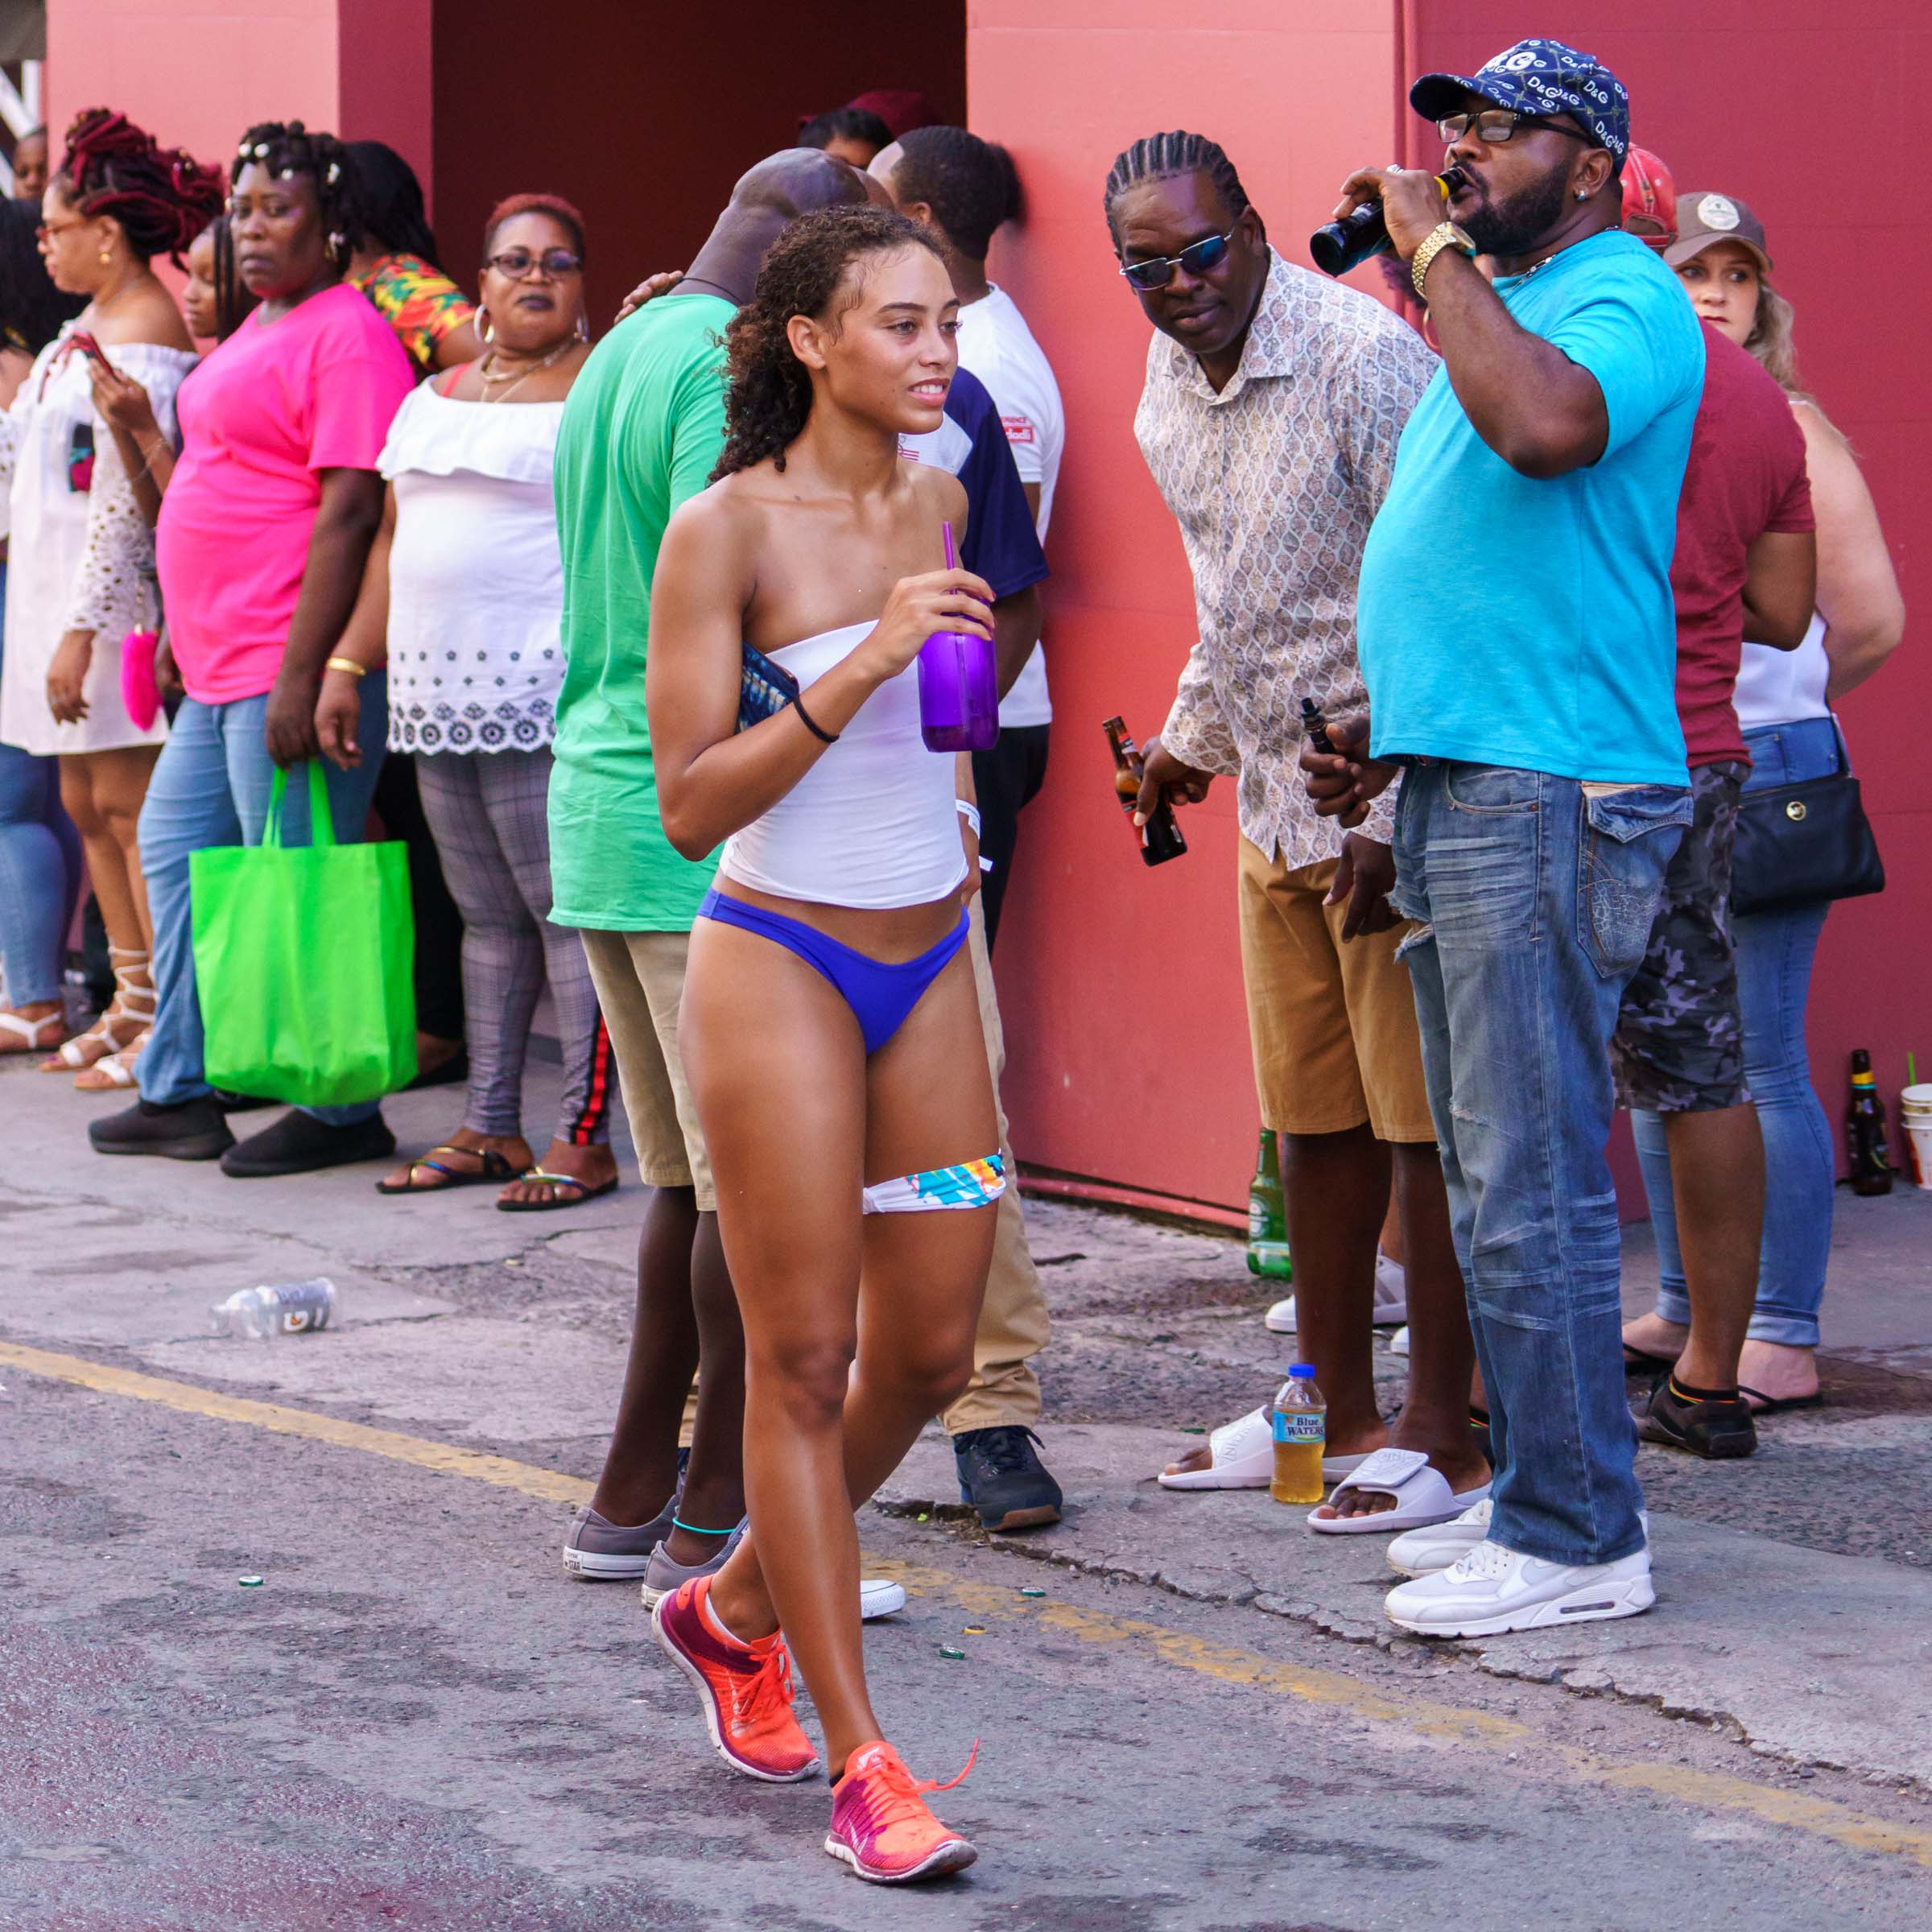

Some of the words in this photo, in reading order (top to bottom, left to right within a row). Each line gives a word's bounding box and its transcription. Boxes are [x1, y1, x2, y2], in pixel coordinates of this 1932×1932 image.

[1527, 76, 1558, 97] D&G
[1583, 80, 1608, 104] D&G
[1596, 121, 1613, 147] D&G
[1296, 1417, 1319, 1426] Blue
